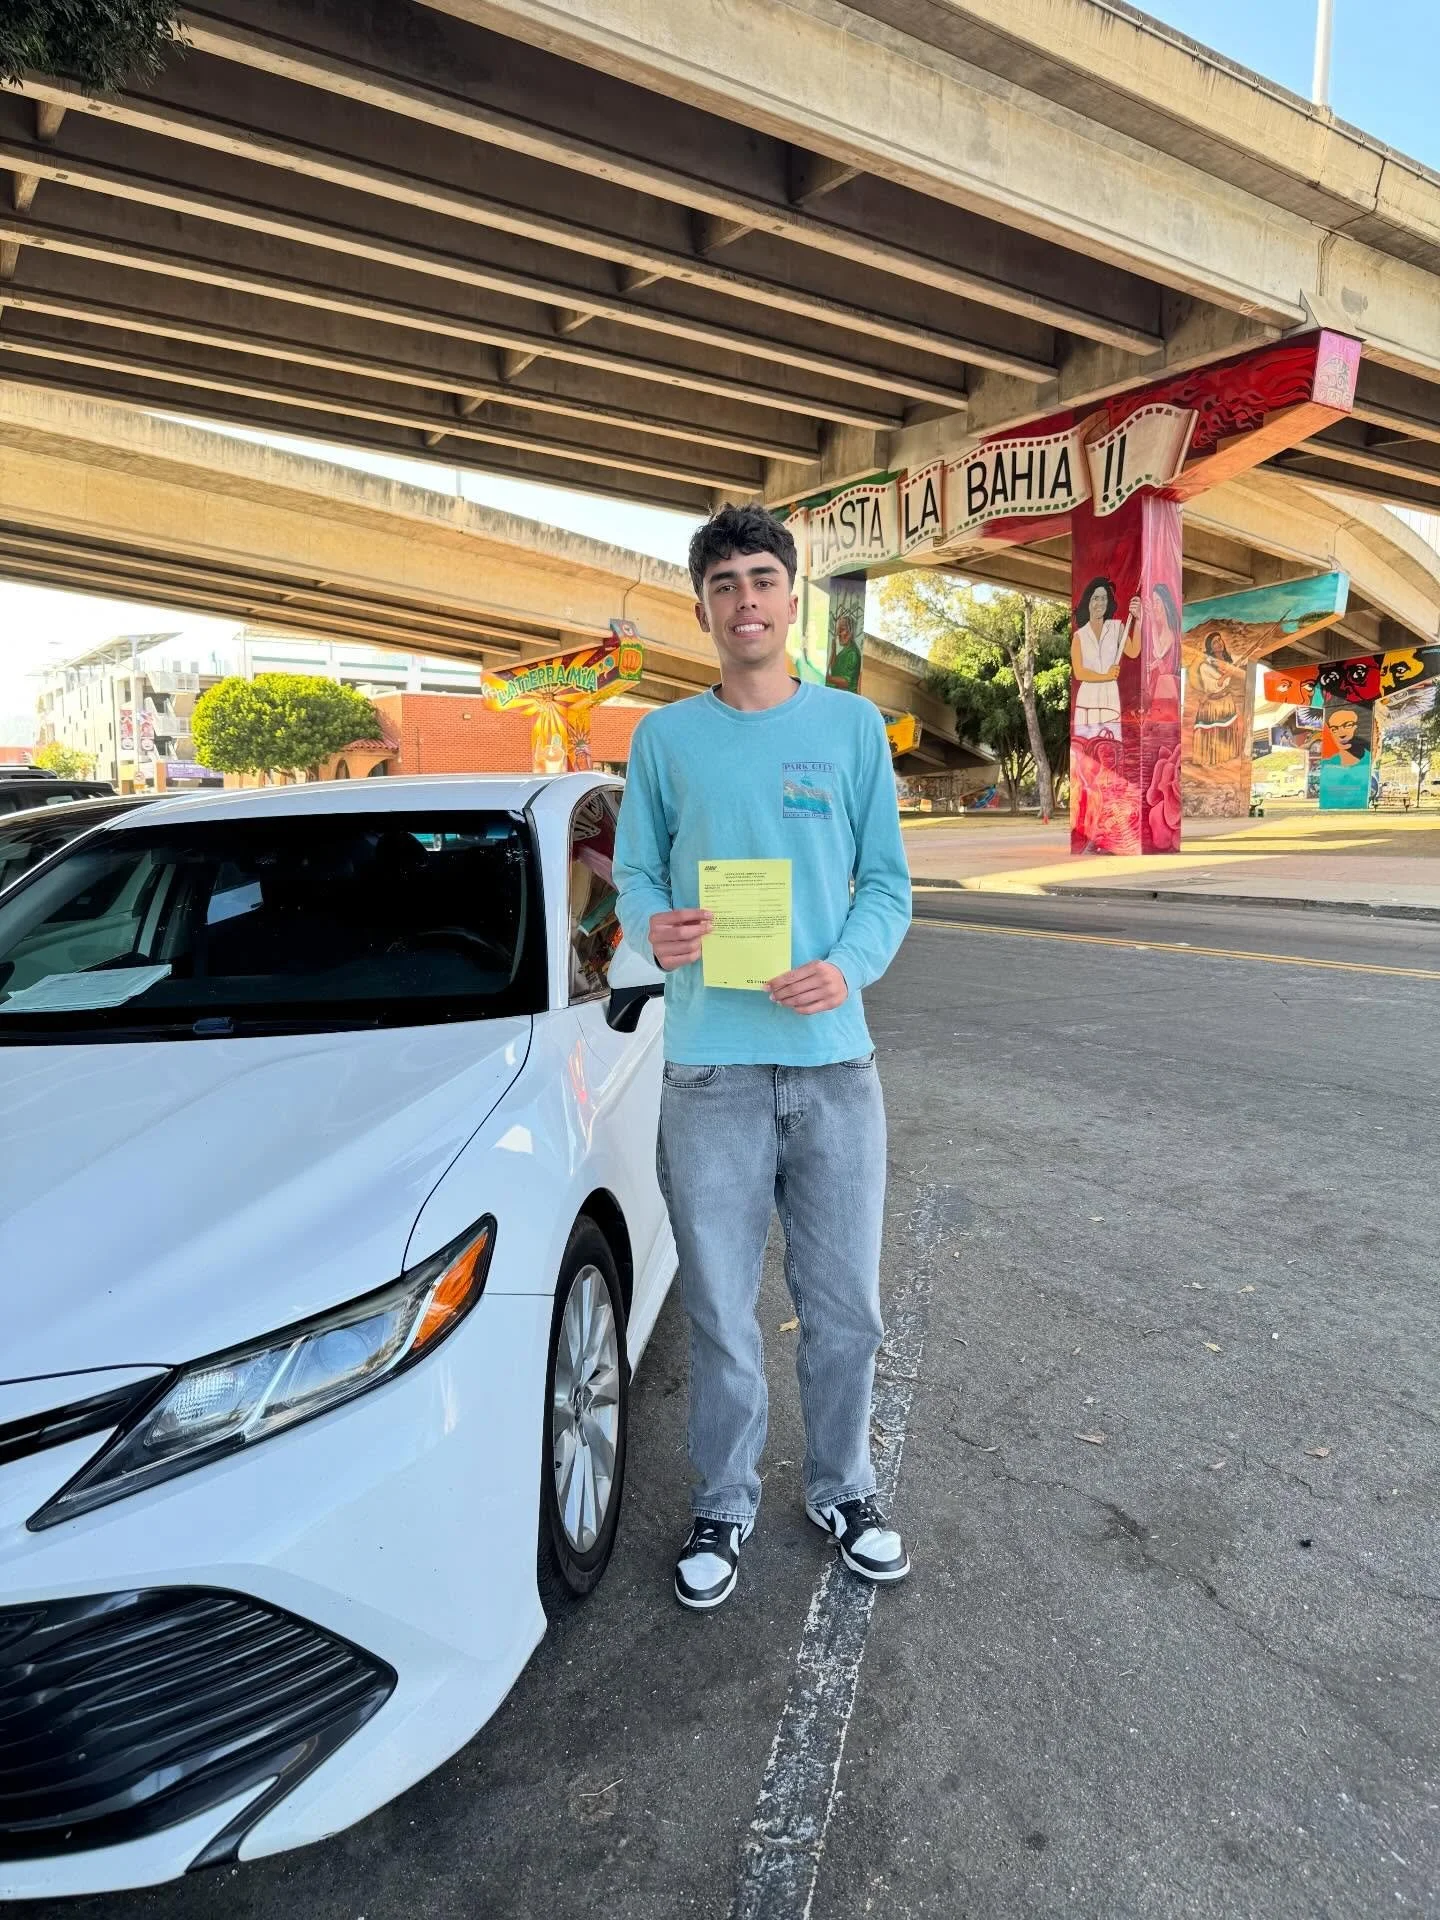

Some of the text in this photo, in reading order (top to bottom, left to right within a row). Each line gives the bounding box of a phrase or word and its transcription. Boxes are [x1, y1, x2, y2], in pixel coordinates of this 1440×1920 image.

[809, 434, 1127, 567] HASTA LA BAHIA !!
[497, 680, 516, 706] LA
[811, 763, 832, 771] CITY
